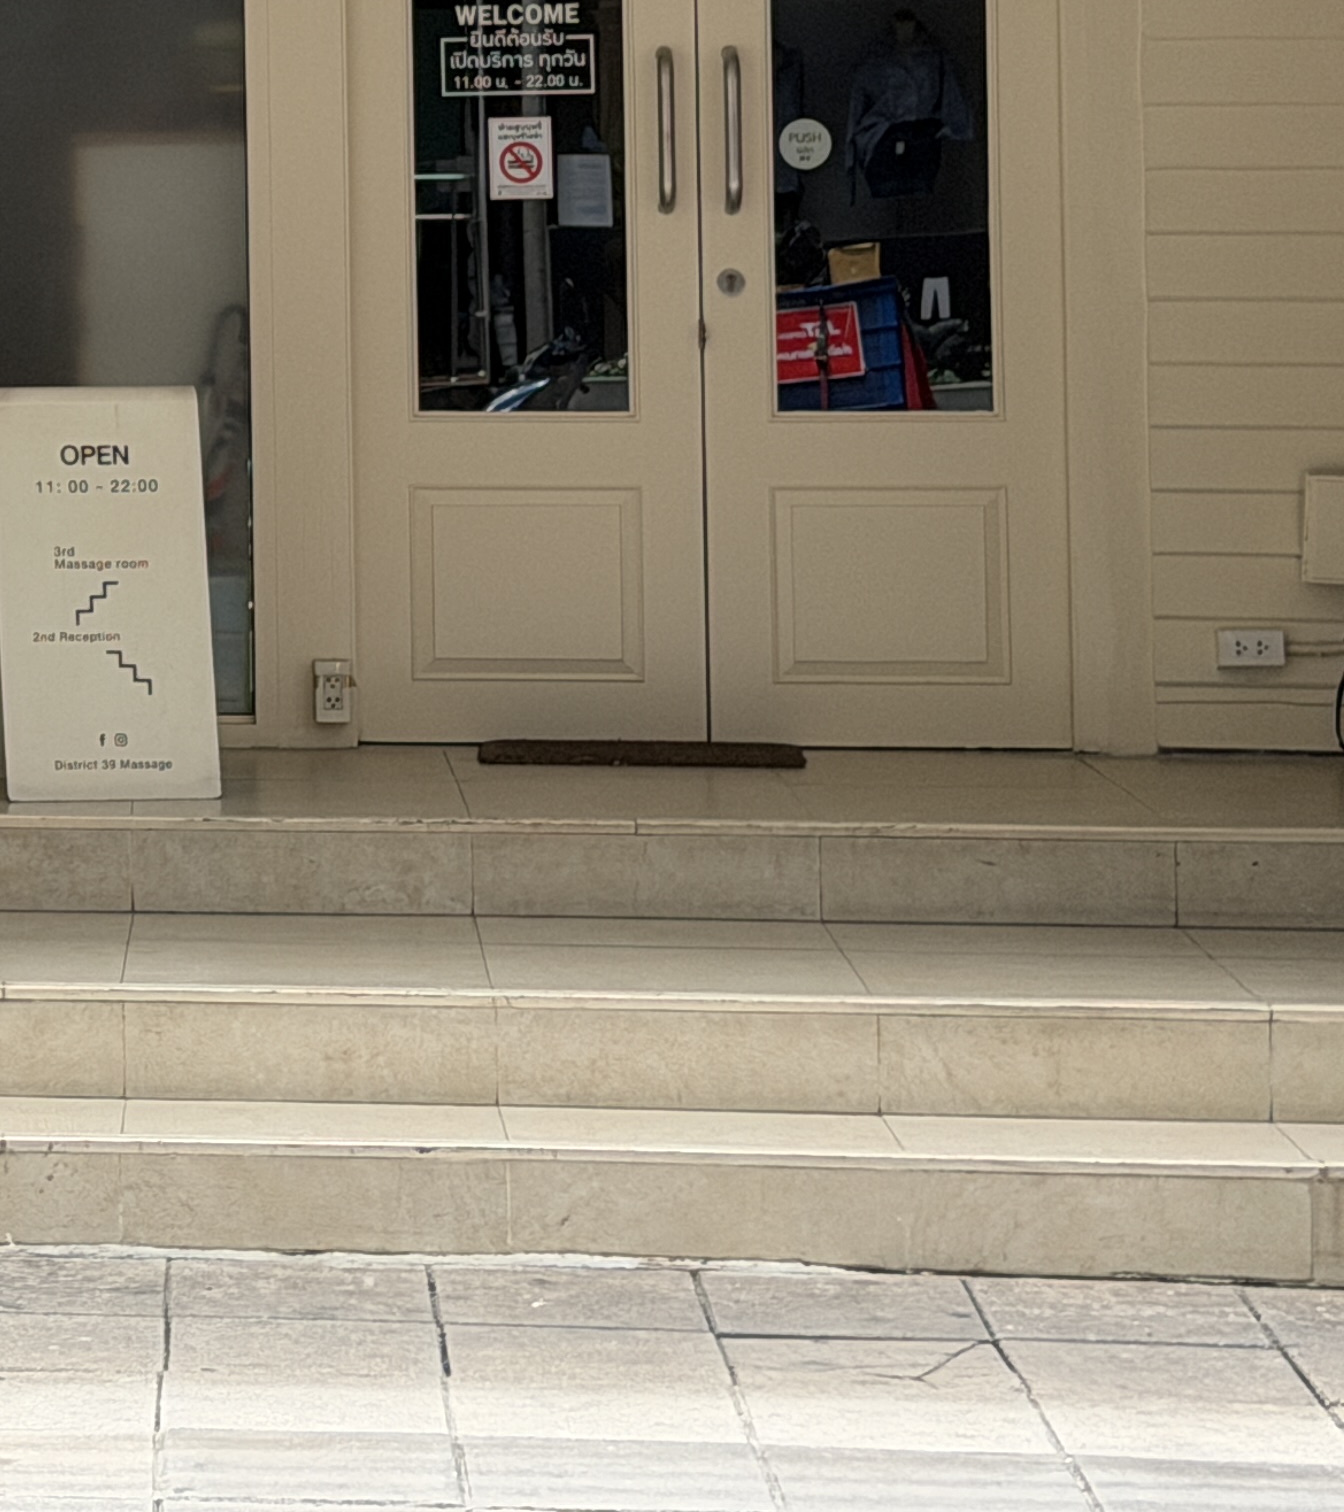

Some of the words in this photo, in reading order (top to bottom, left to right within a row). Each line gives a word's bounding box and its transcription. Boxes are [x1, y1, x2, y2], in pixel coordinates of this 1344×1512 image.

[454, 1, 581, 27] WELCOME
[788, 132, 822, 143] PUSH
[60, 444, 130, 467] OPEN
[110, 479, 159, 494] 22:00
[53, 546, 75, 557] 3rd
[54, 559, 112, 571] Massage
[115, 559, 150, 570] room
[33, 632, 56, 643] 2nd
[60, 631, 121, 643] Reception
[54, 759, 99, 771] District
[101, 759, 117, 771] 39
[120, 759, 173, 772] Massage
